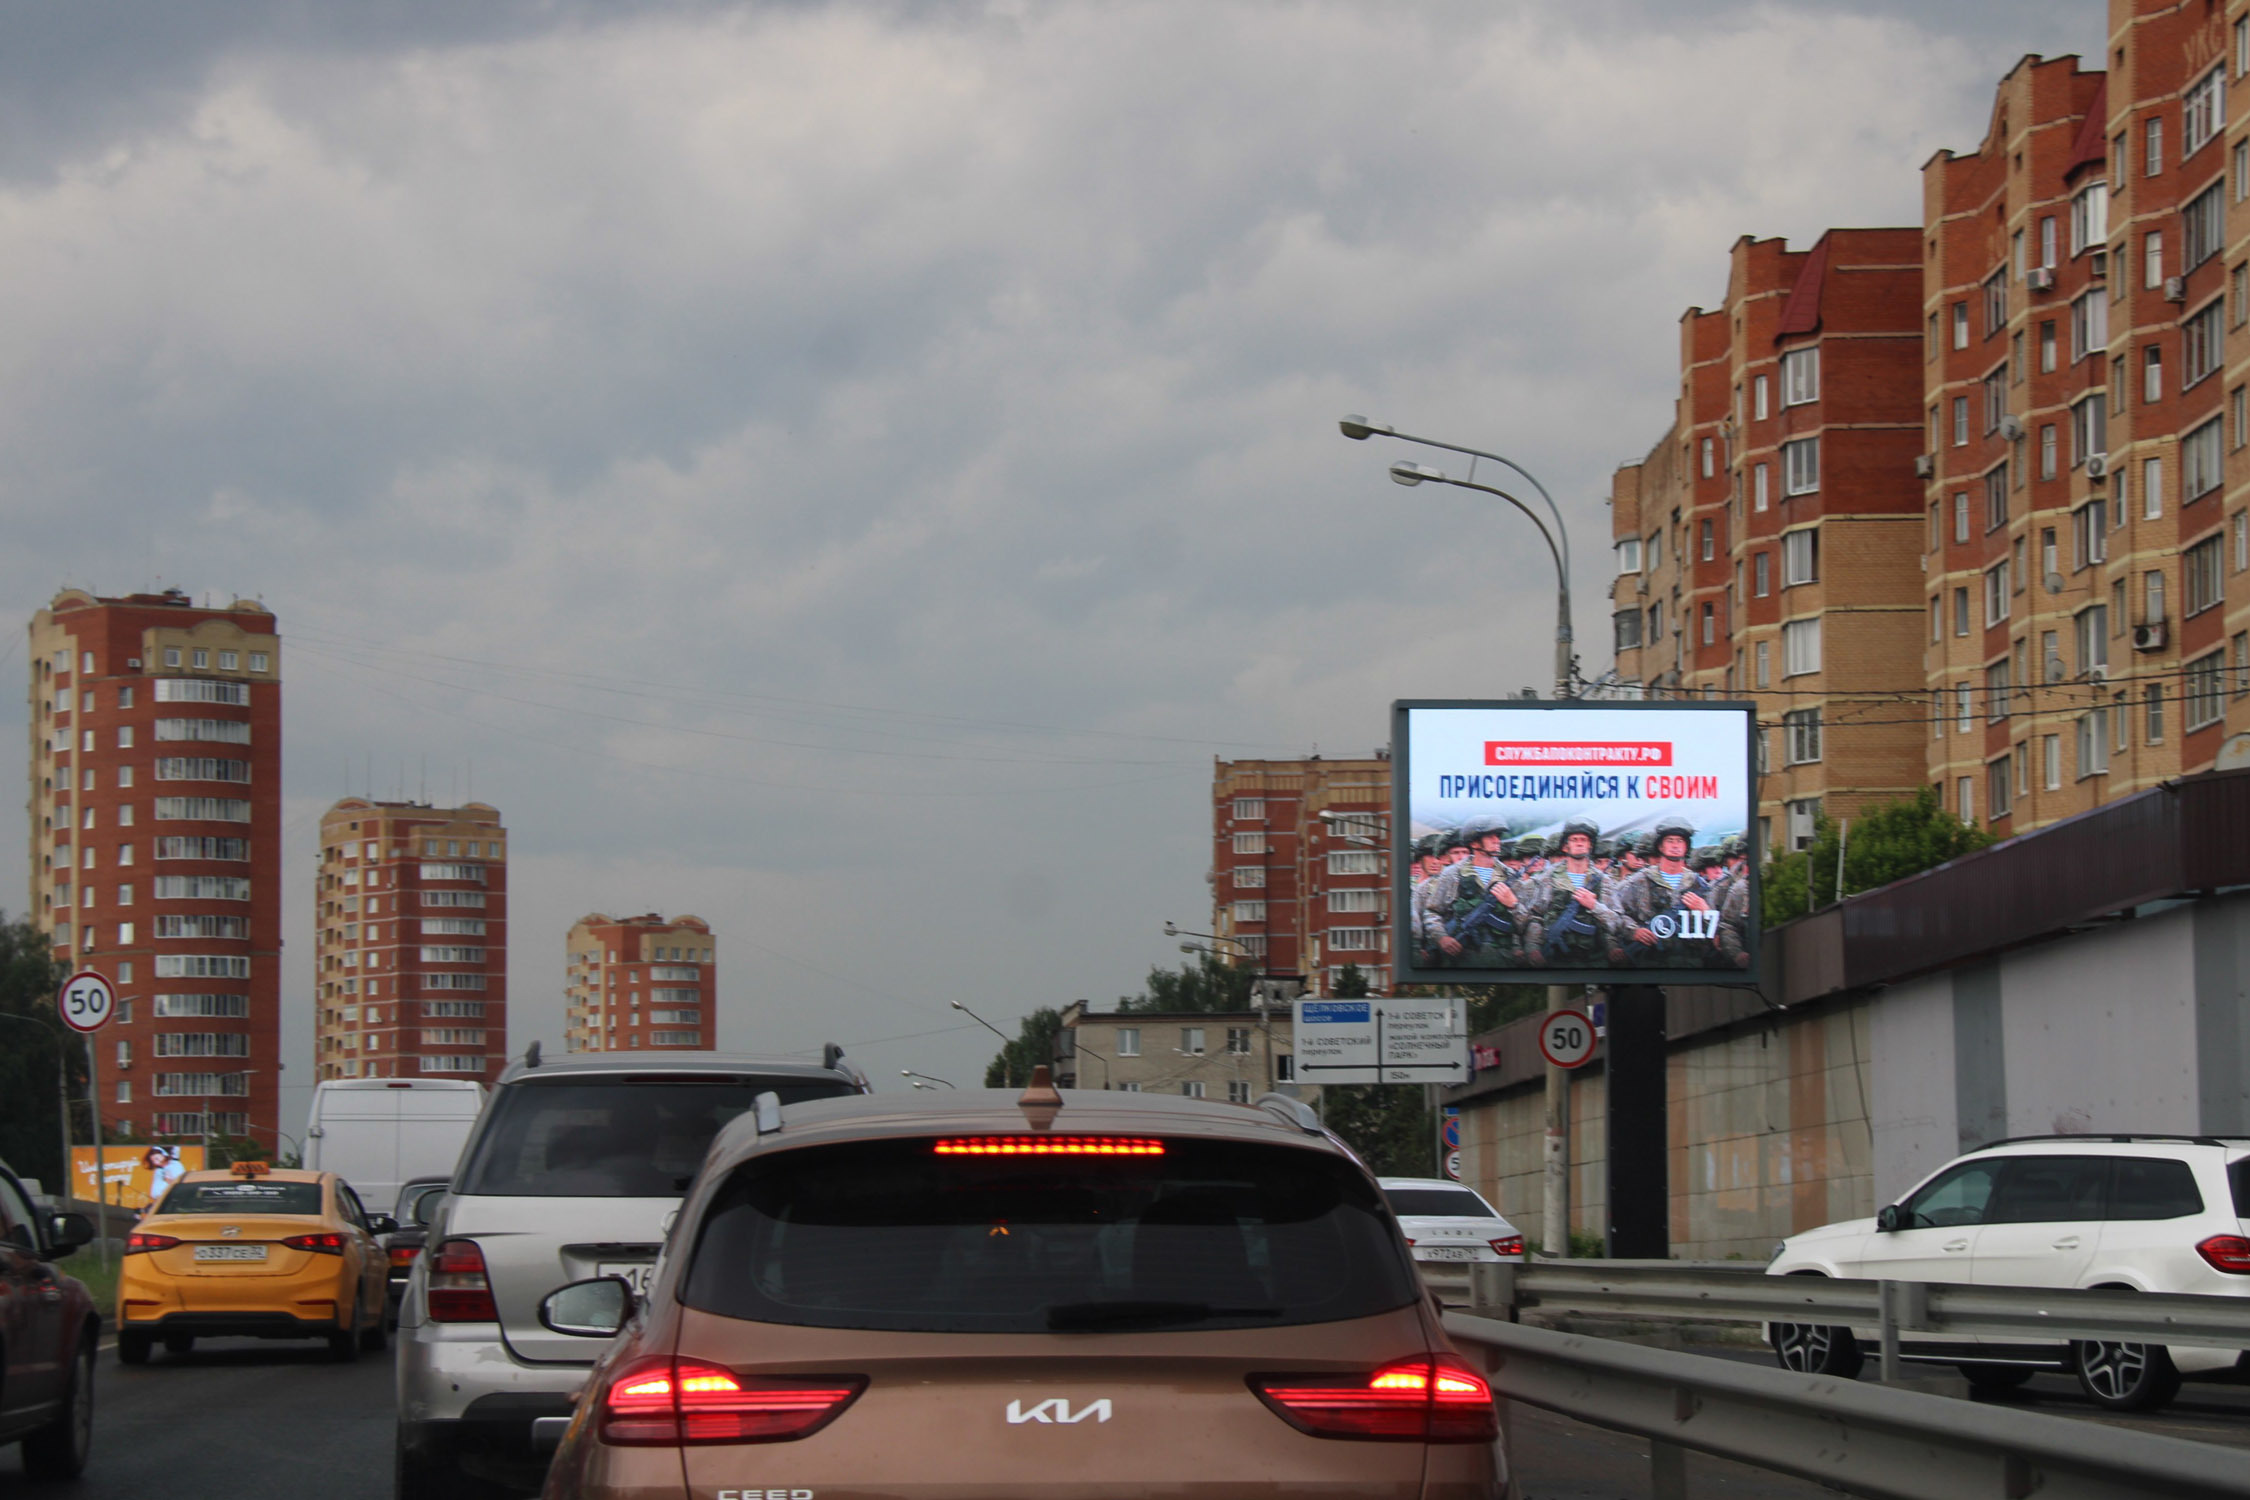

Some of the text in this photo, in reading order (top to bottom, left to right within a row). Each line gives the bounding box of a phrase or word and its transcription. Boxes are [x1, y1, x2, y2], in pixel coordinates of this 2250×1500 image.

[1495, 747, 1661, 761] СЛУЖБАПОКОНТРАКТУ.РФ
[1440, 770, 1718, 801] ПРИСОЕДИНЯЙСЯ К СВОИМ
[1677, 909, 1720, 939] 117
[71, 988, 105, 1015] 50
[1552, 1027, 1582, 1050] 50
[1006, 1399, 1112, 1424] KIA
[718, 1489, 814, 1500] CEED
